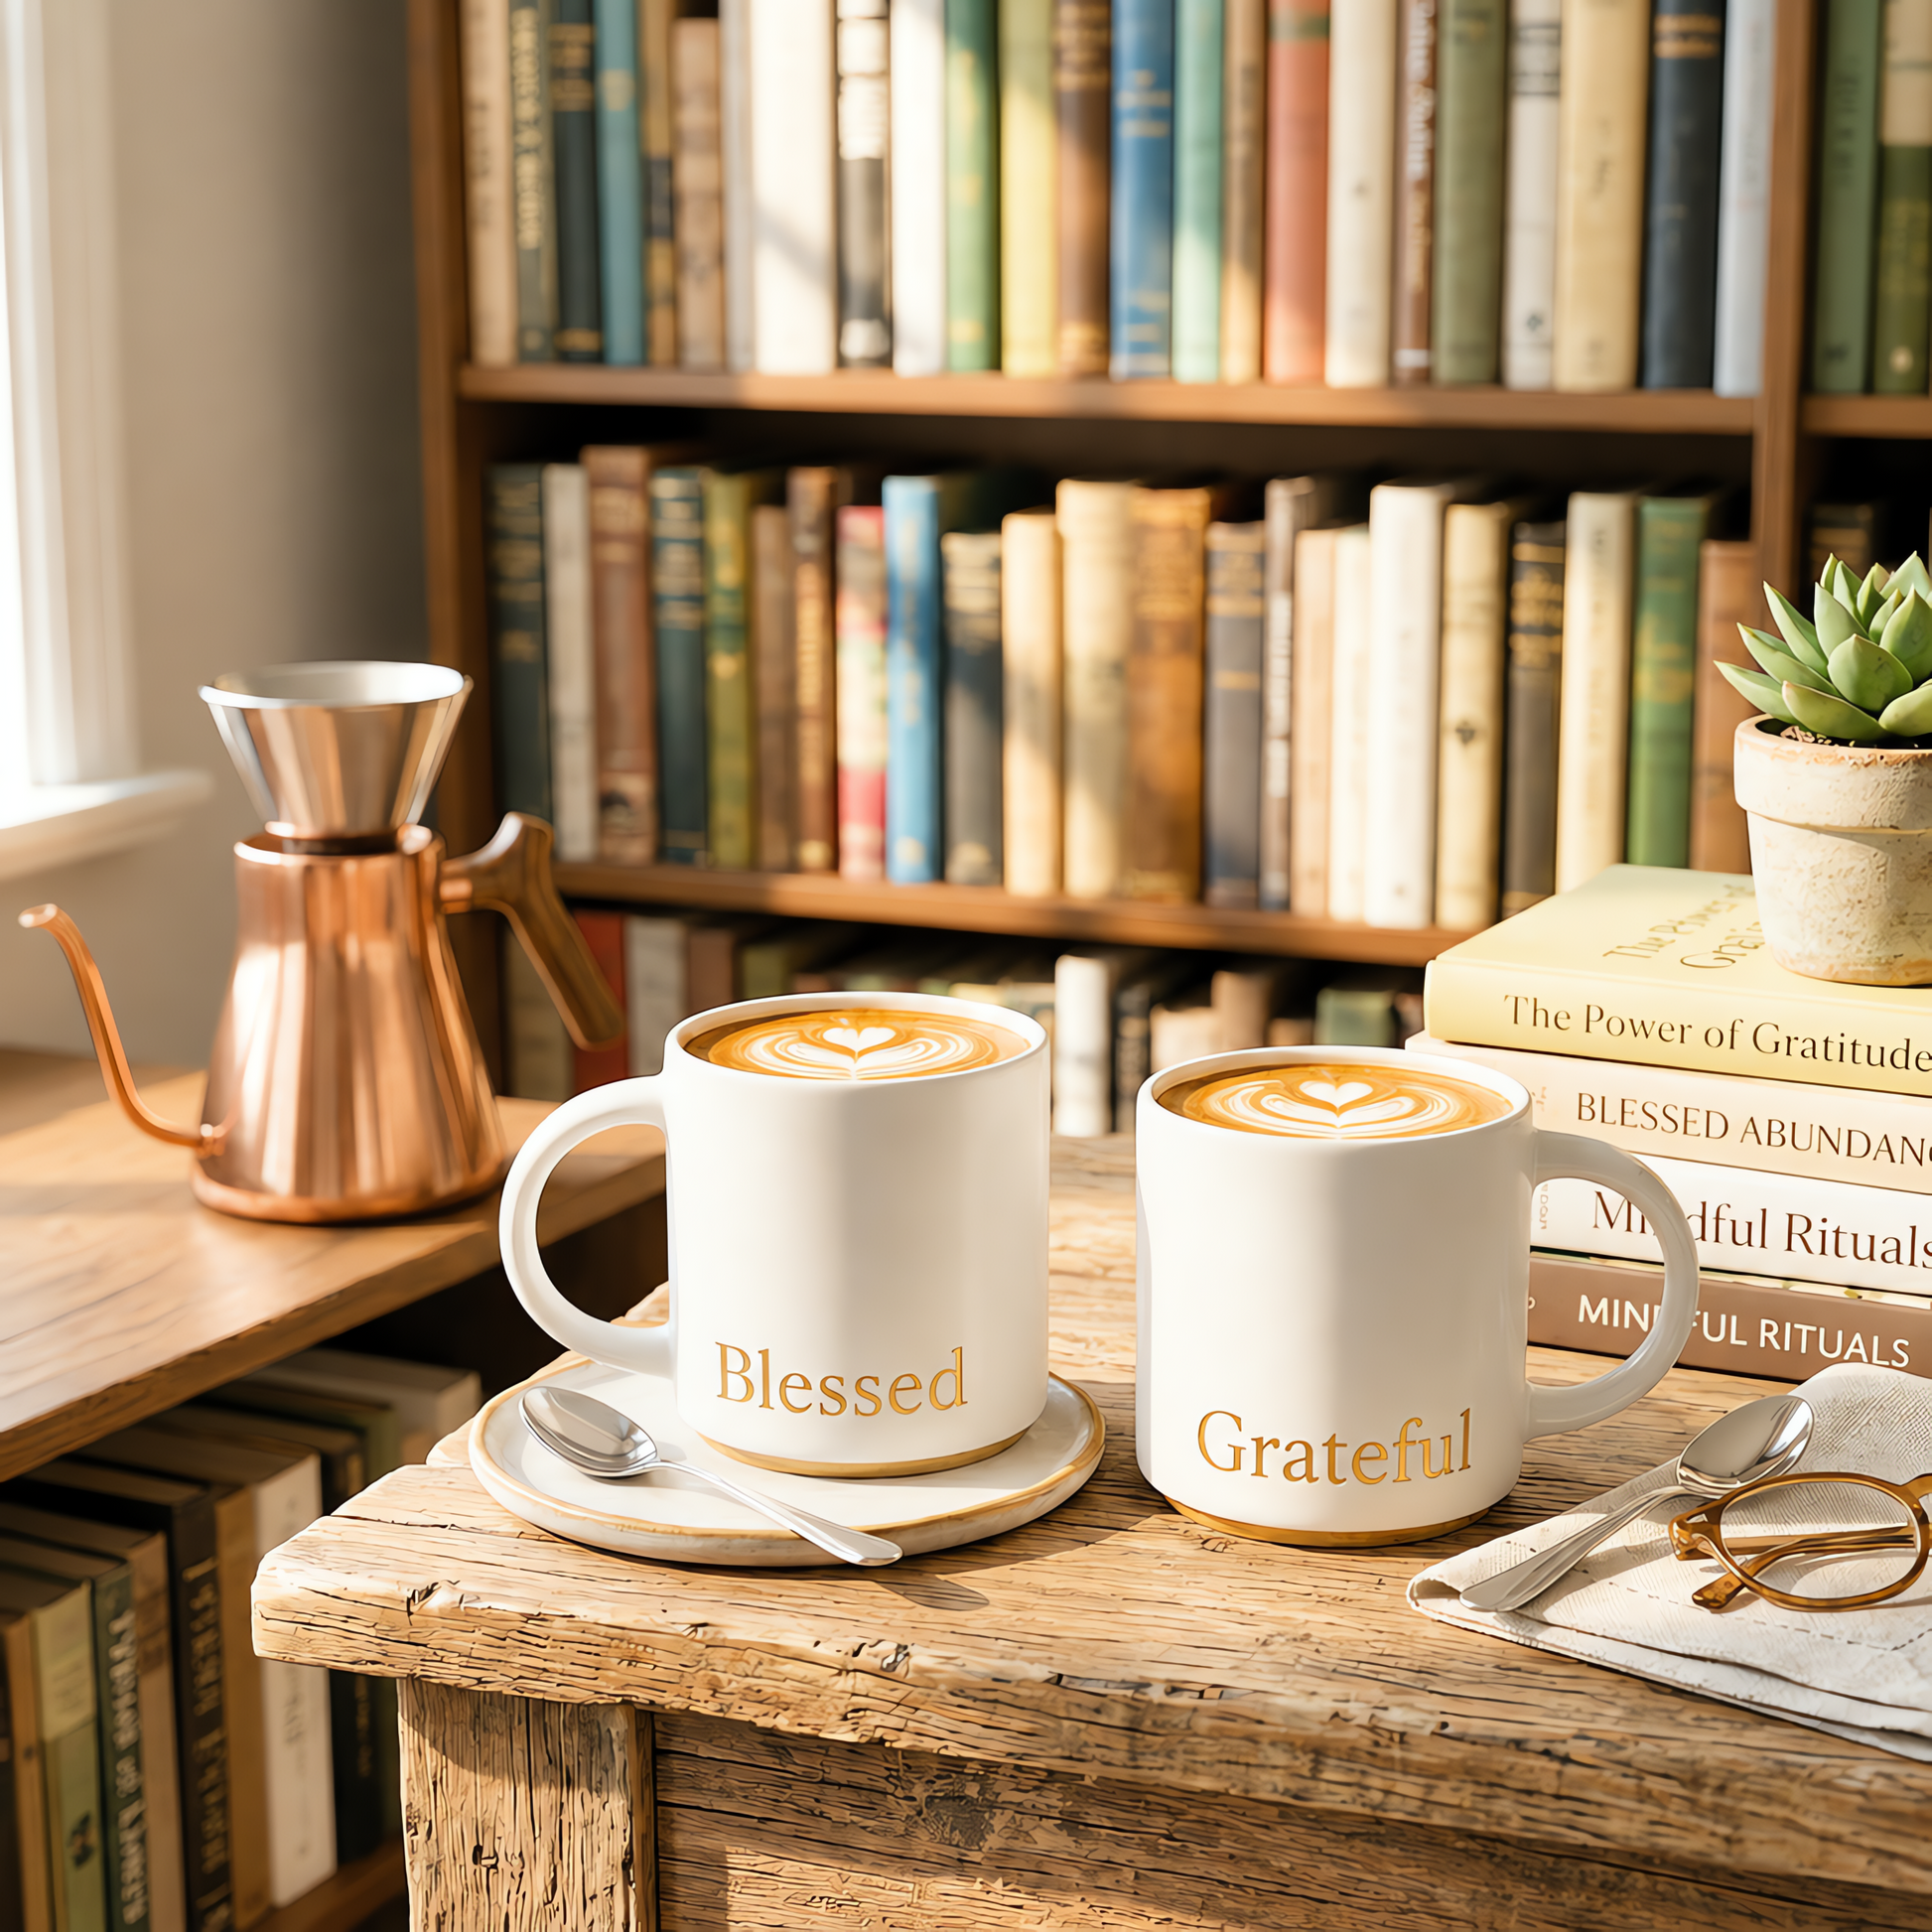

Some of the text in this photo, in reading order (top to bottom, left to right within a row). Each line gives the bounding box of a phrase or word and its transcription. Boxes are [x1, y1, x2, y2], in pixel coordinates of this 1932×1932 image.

[1503, 994, 1932, 1072] The Power of Gratitude
[1577, 1092, 1729, 1140] BLESSED
[1739, 1116, 1932, 1167] ABUNDAN
[1591, 1190, 1768, 1249] Midful
[1578, 1294, 1910, 1368] MINUL RITUALS
[714, 1341, 969, 1417] Blessed
[1197, 1407, 1471, 1485] Grateful
